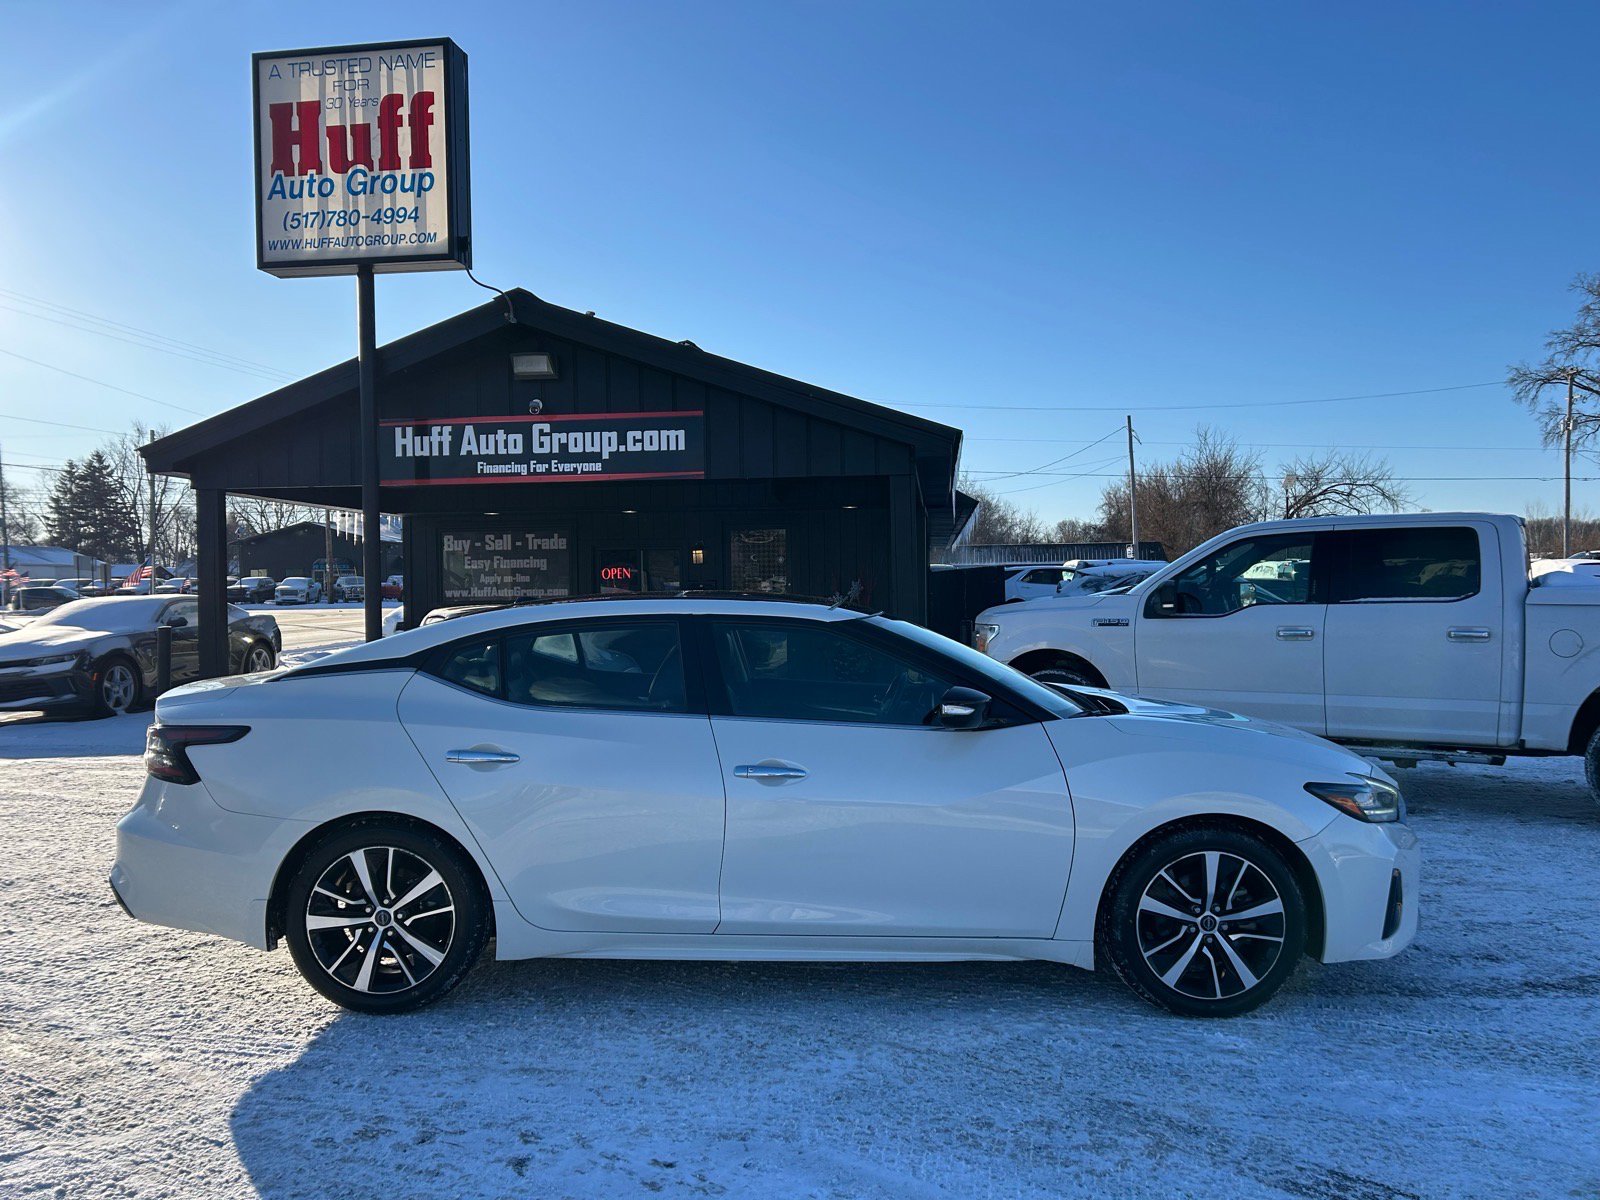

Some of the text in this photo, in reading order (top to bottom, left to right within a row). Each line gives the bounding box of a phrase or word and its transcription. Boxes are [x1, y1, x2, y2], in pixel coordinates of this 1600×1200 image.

[269, 52, 436, 80] A TRUSTED NAME
[332, 78, 370, 92] FOR
[326, 95, 379, 110] 30 Years
[269, 91, 435, 178] Huff
[267, 168, 435, 200] Auto Group
[282, 206, 420, 231] (517)780-4994
[268, 232, 437, 251] WWW.HUFFAUTOGROUP.COM
[394, 423, 686, 460] Huff Auto Group.com
[477, 459, 603, 475] Financing For Everyone
[443, 534, 471, 554] Buy
[484, 534, 512, 551] Sell
[525, 533, 567, 550] Trade
[464, 555, 548, 571] Easy Financing
[480, 573, 502, 584] Apply
[601, 567, 631, 580] OPEN
